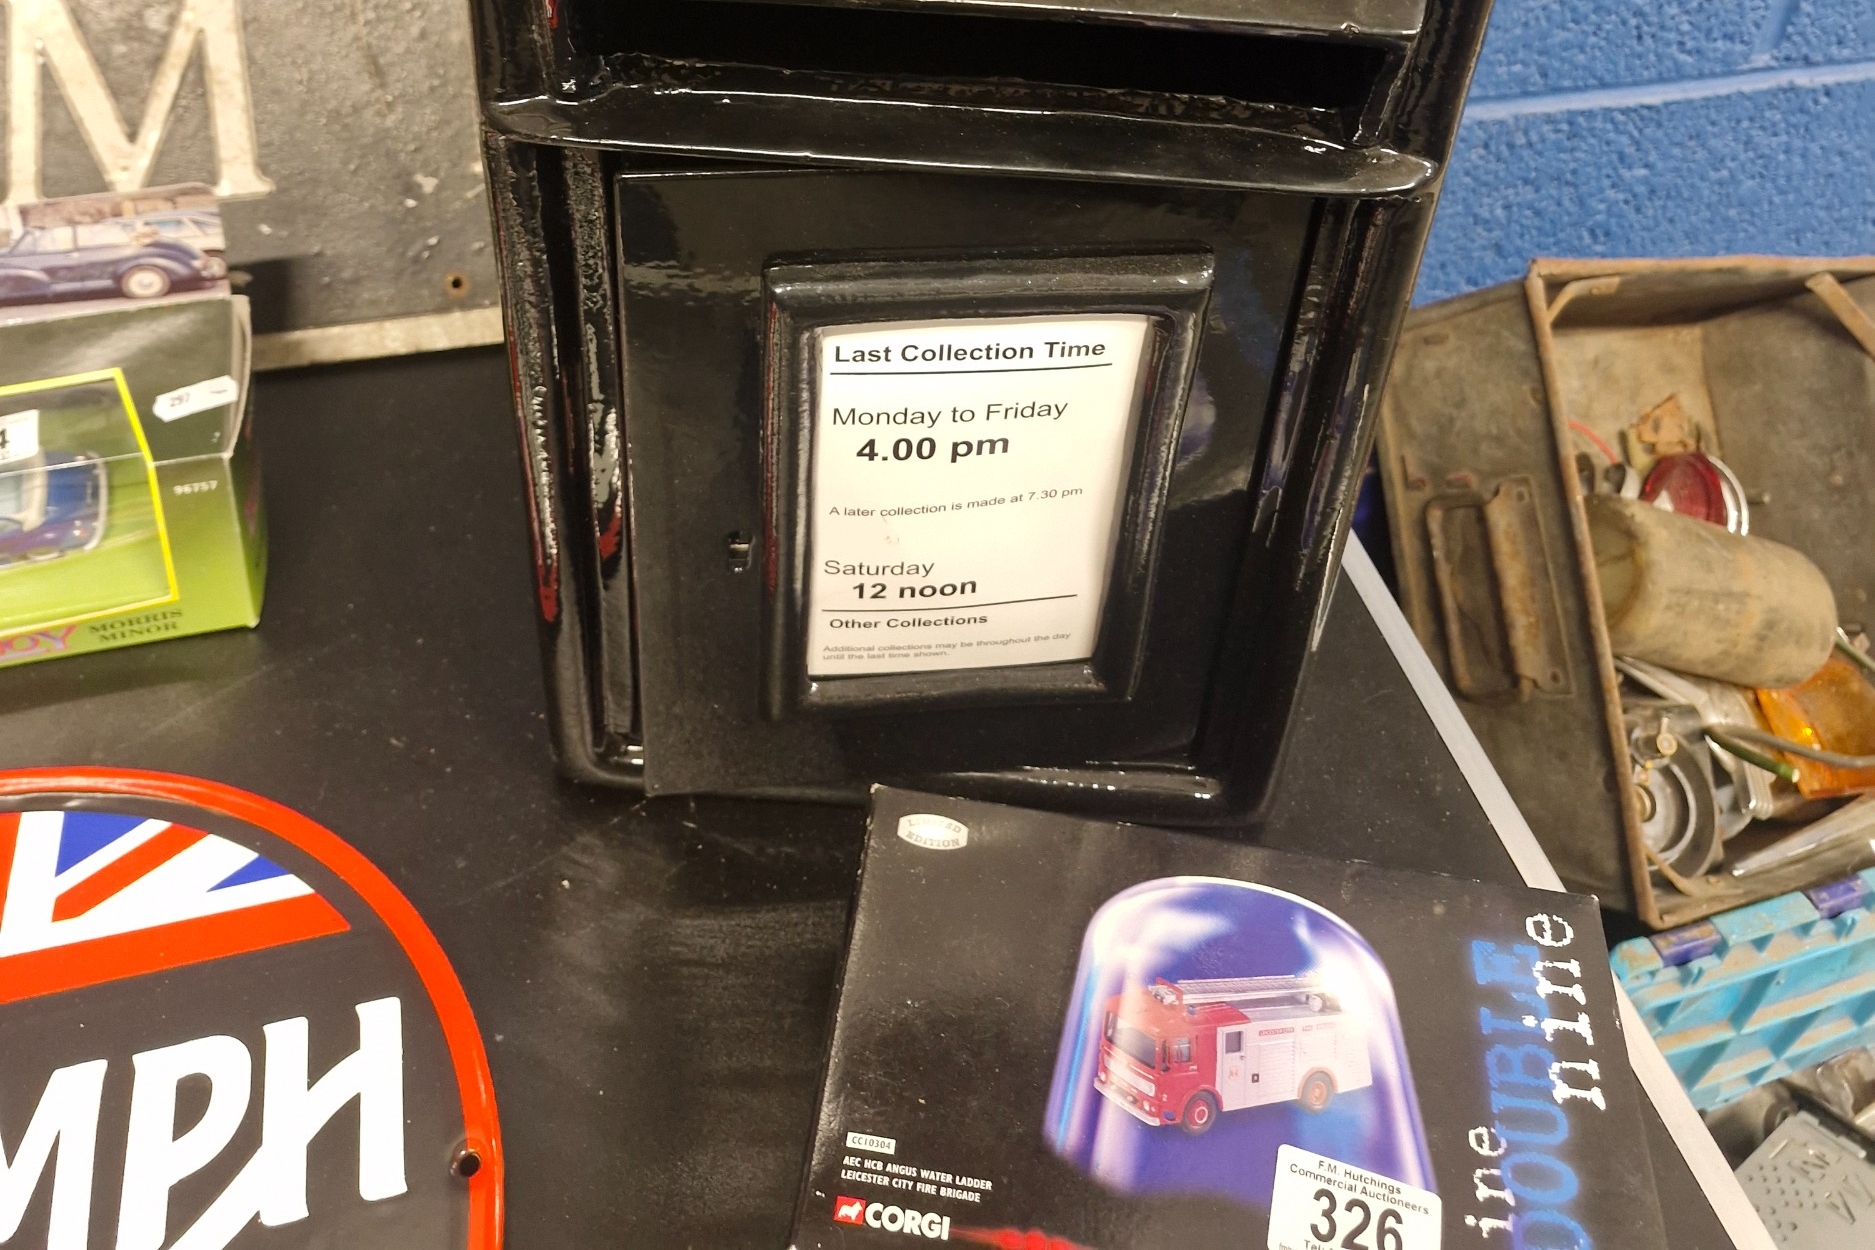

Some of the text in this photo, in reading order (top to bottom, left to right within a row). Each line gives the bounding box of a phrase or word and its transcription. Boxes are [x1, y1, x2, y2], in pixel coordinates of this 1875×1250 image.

[835, 341, 1106, 363] Last Collection Time
[832, 400, 1069, 428] Monday to Friday
[856, 437, 1009, 463] 4.00 pm
[829, 487, 1083, 517] A later collection is made at 7.30 pm
[824, 560, 935, 578] Saturday
[852, 580, 977, 599] 12 noon
[88, 609, 183, 634] MORRIS
[100, 621, 178, 642] MINOR
[829, 615, 988, 629] Other Collections
[823, 632, 1071, 652] Additional collections may be throughout the day
[888, 651, 910, 659] time
[913, 650, 949, 659] shown.
[906, 830, 960, 848] EDITION
[1525, 913, 1606, 1111] nine
[851, 1135, 891, 1149] CC10304
[843, 1155, 993, 1191] AEC HCB ANGUS WATER LADDER
[1318, 1160, 1402, 1195] F.M. Hutchings
[841, 1169, 981, 1203] LEICESTER CITY FIRE BRIGADE
[1290, 1163, 1430, 1215] Commercial Auctioneers
[865, 1202, 951, 1241] CORGI
[1310, 1188, 1403, 1250] 326
